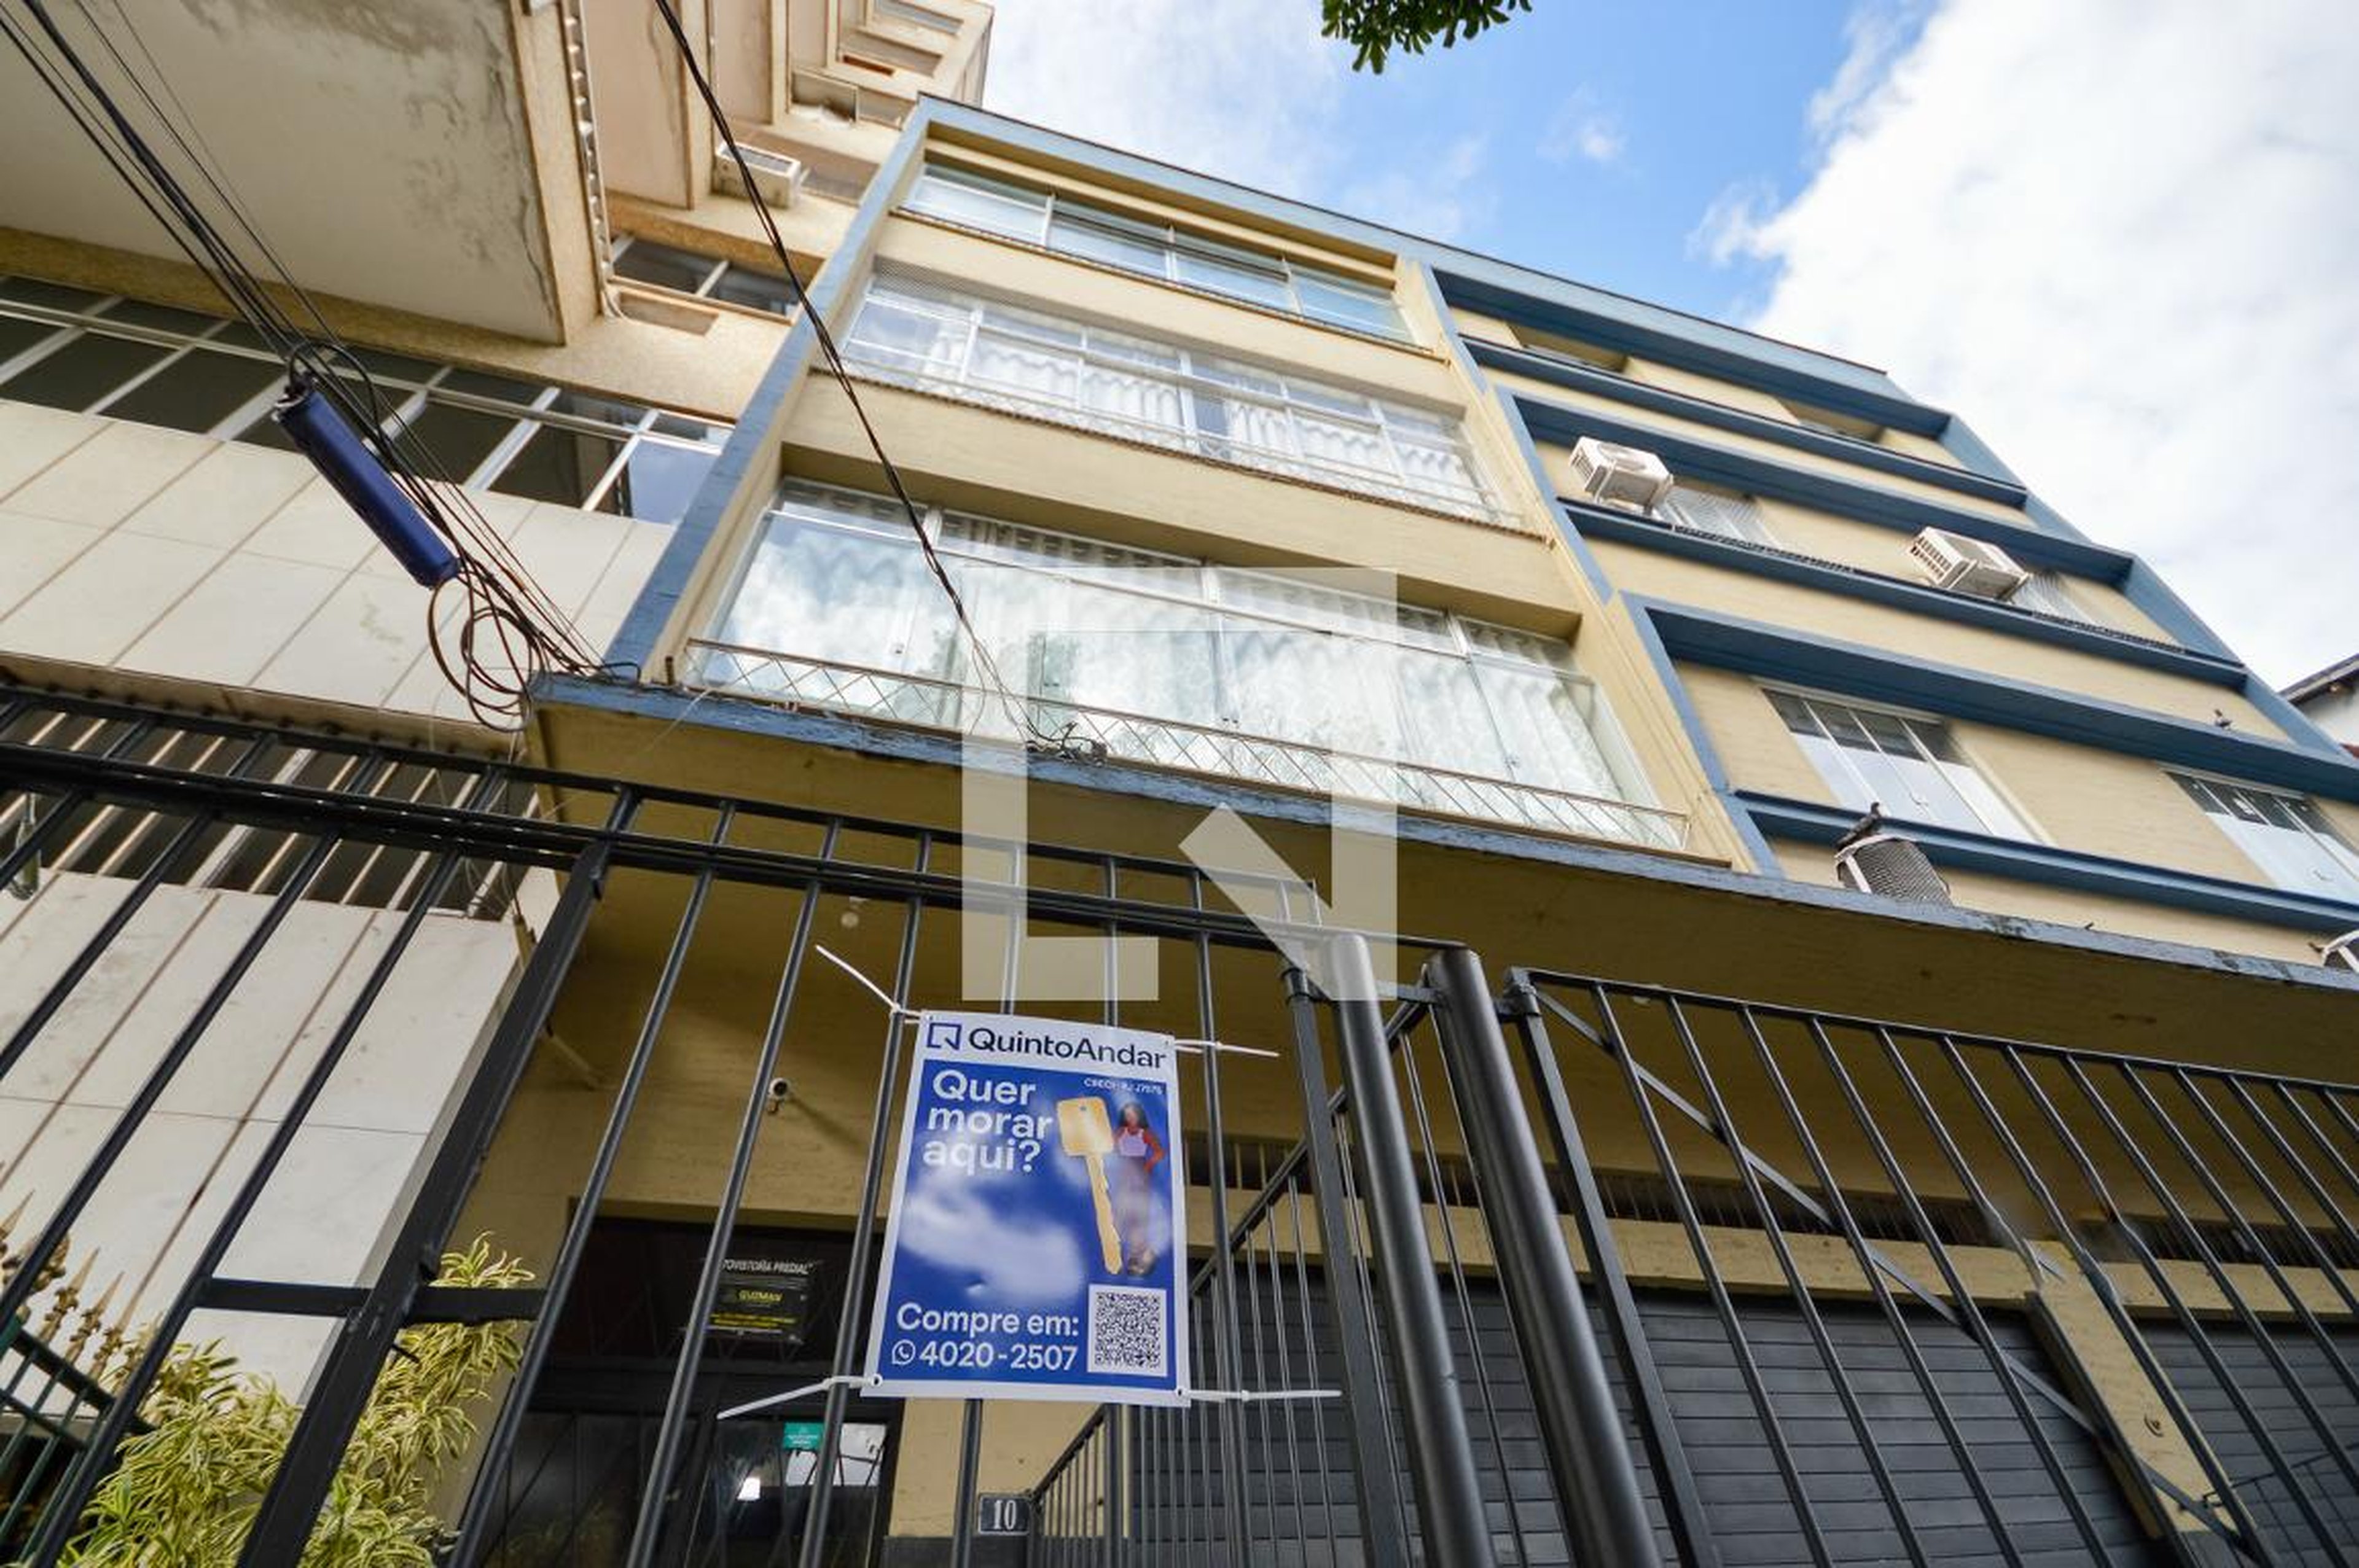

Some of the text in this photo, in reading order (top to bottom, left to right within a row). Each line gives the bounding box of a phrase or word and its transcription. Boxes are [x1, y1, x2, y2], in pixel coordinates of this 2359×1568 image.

[968, 1028, 1167, 1069] QuintoAndar
[932, 1069, 1036, 1106] Quer
[927, 1106, 1053, 1141] morar
[922, 1139, 1042, 1177] aqui?
[897, 1302, 1079, 1338] Compre em:
[993, 1499, 1017, 1531] 10
